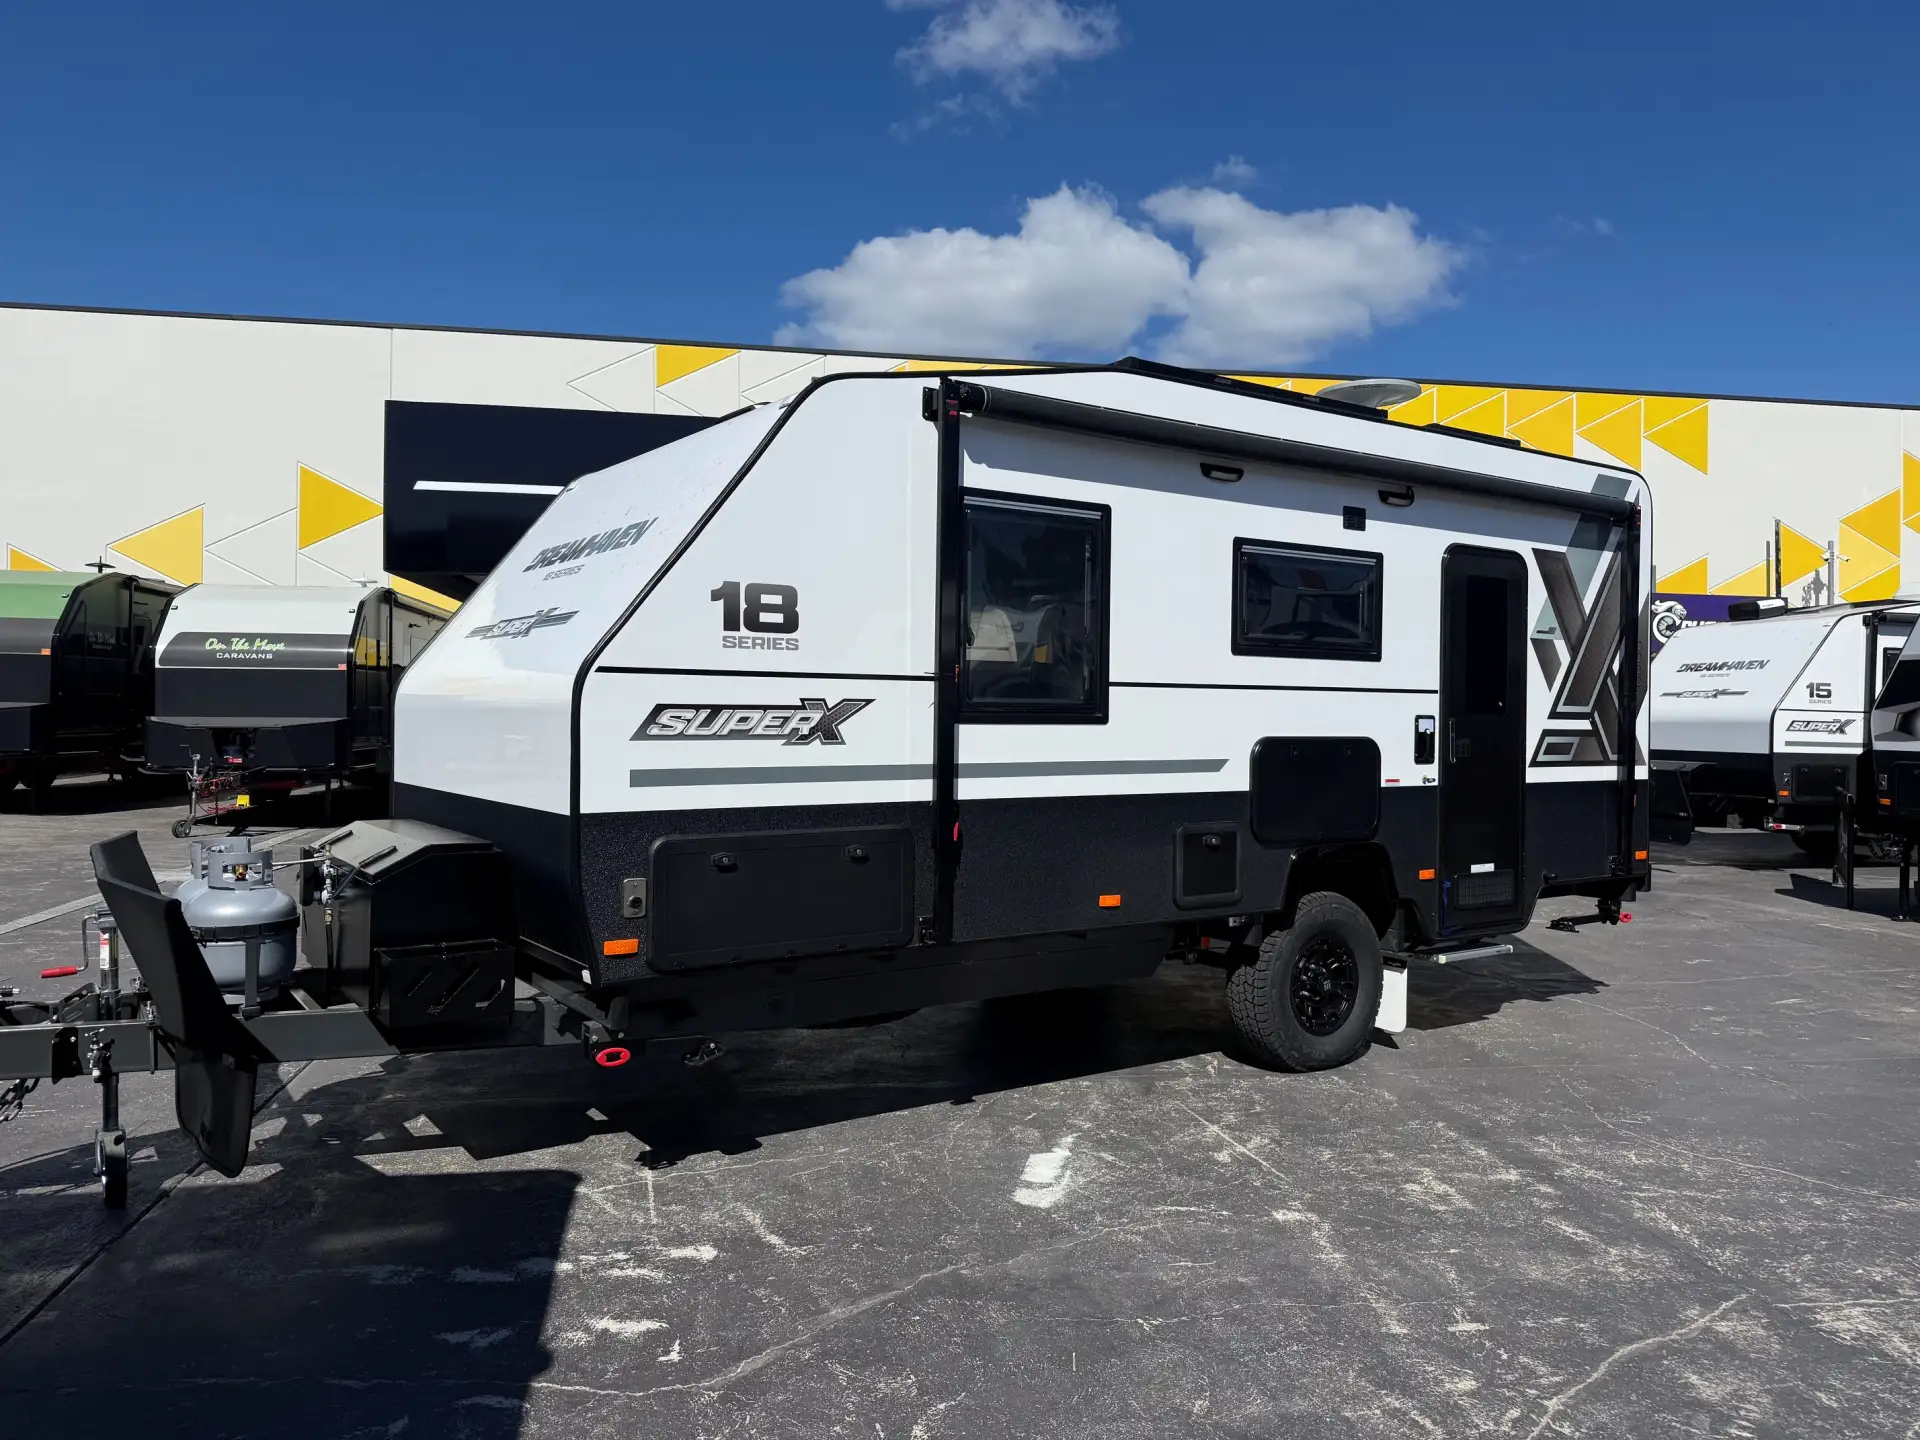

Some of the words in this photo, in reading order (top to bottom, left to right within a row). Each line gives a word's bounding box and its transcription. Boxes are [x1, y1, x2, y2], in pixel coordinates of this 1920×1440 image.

[521, 516, 660, 573] DREAMHAVEN
[710, 580, 800, 635] 18
[205, 638, 227, 650] On
[230, 638, 250, 651] The
[252, 638, 286, 651] Move
[721, 635, 800, 652] SERIES
[216, 652, 273, 660] CARAVANS
[1676, 659, 1771, 673] DREAMHAVEN
[1805, 682, 1832, 699] 15
[640, 697, 877, 746] SUPERX
